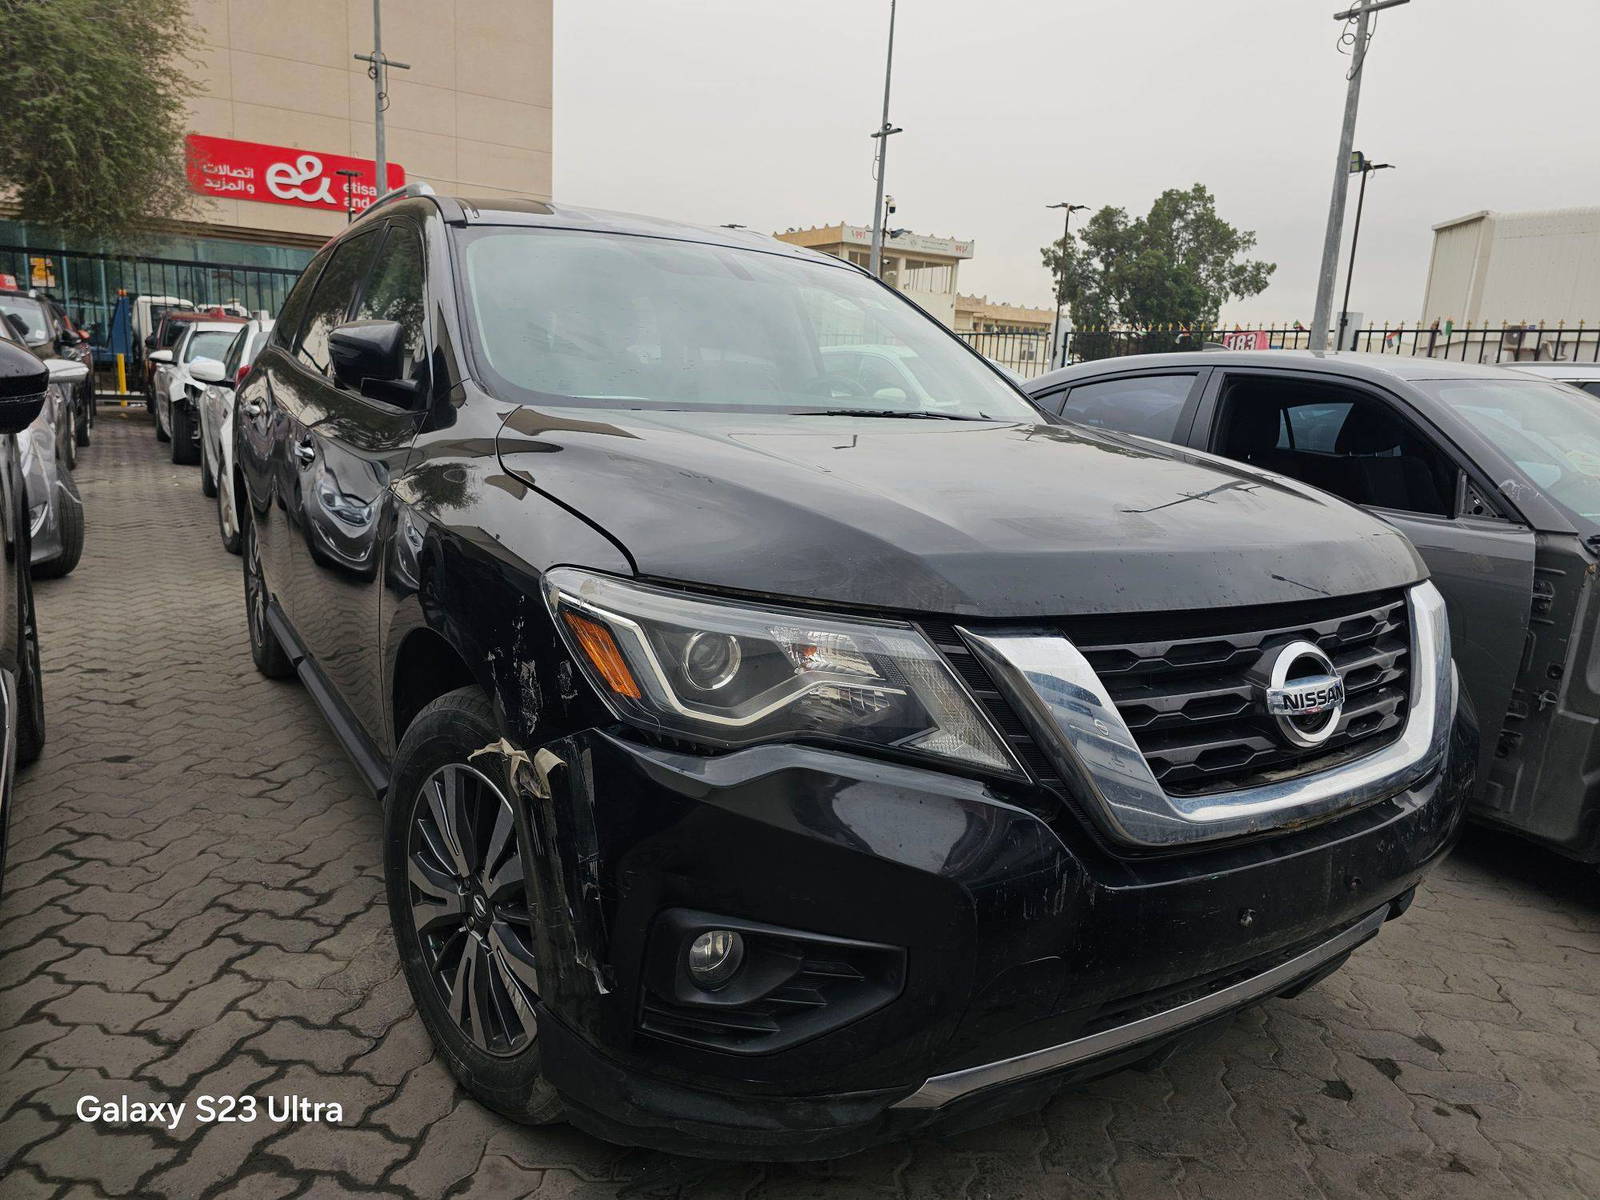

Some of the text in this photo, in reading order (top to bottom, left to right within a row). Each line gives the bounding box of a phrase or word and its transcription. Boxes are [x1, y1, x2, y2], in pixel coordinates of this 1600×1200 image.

[202, 163, 254, 178] اتصالات
[343, 182, 392, 197] etisa
[343, 196, 370, 209] and
[1282, 682, 1344, 710] NISSAN
